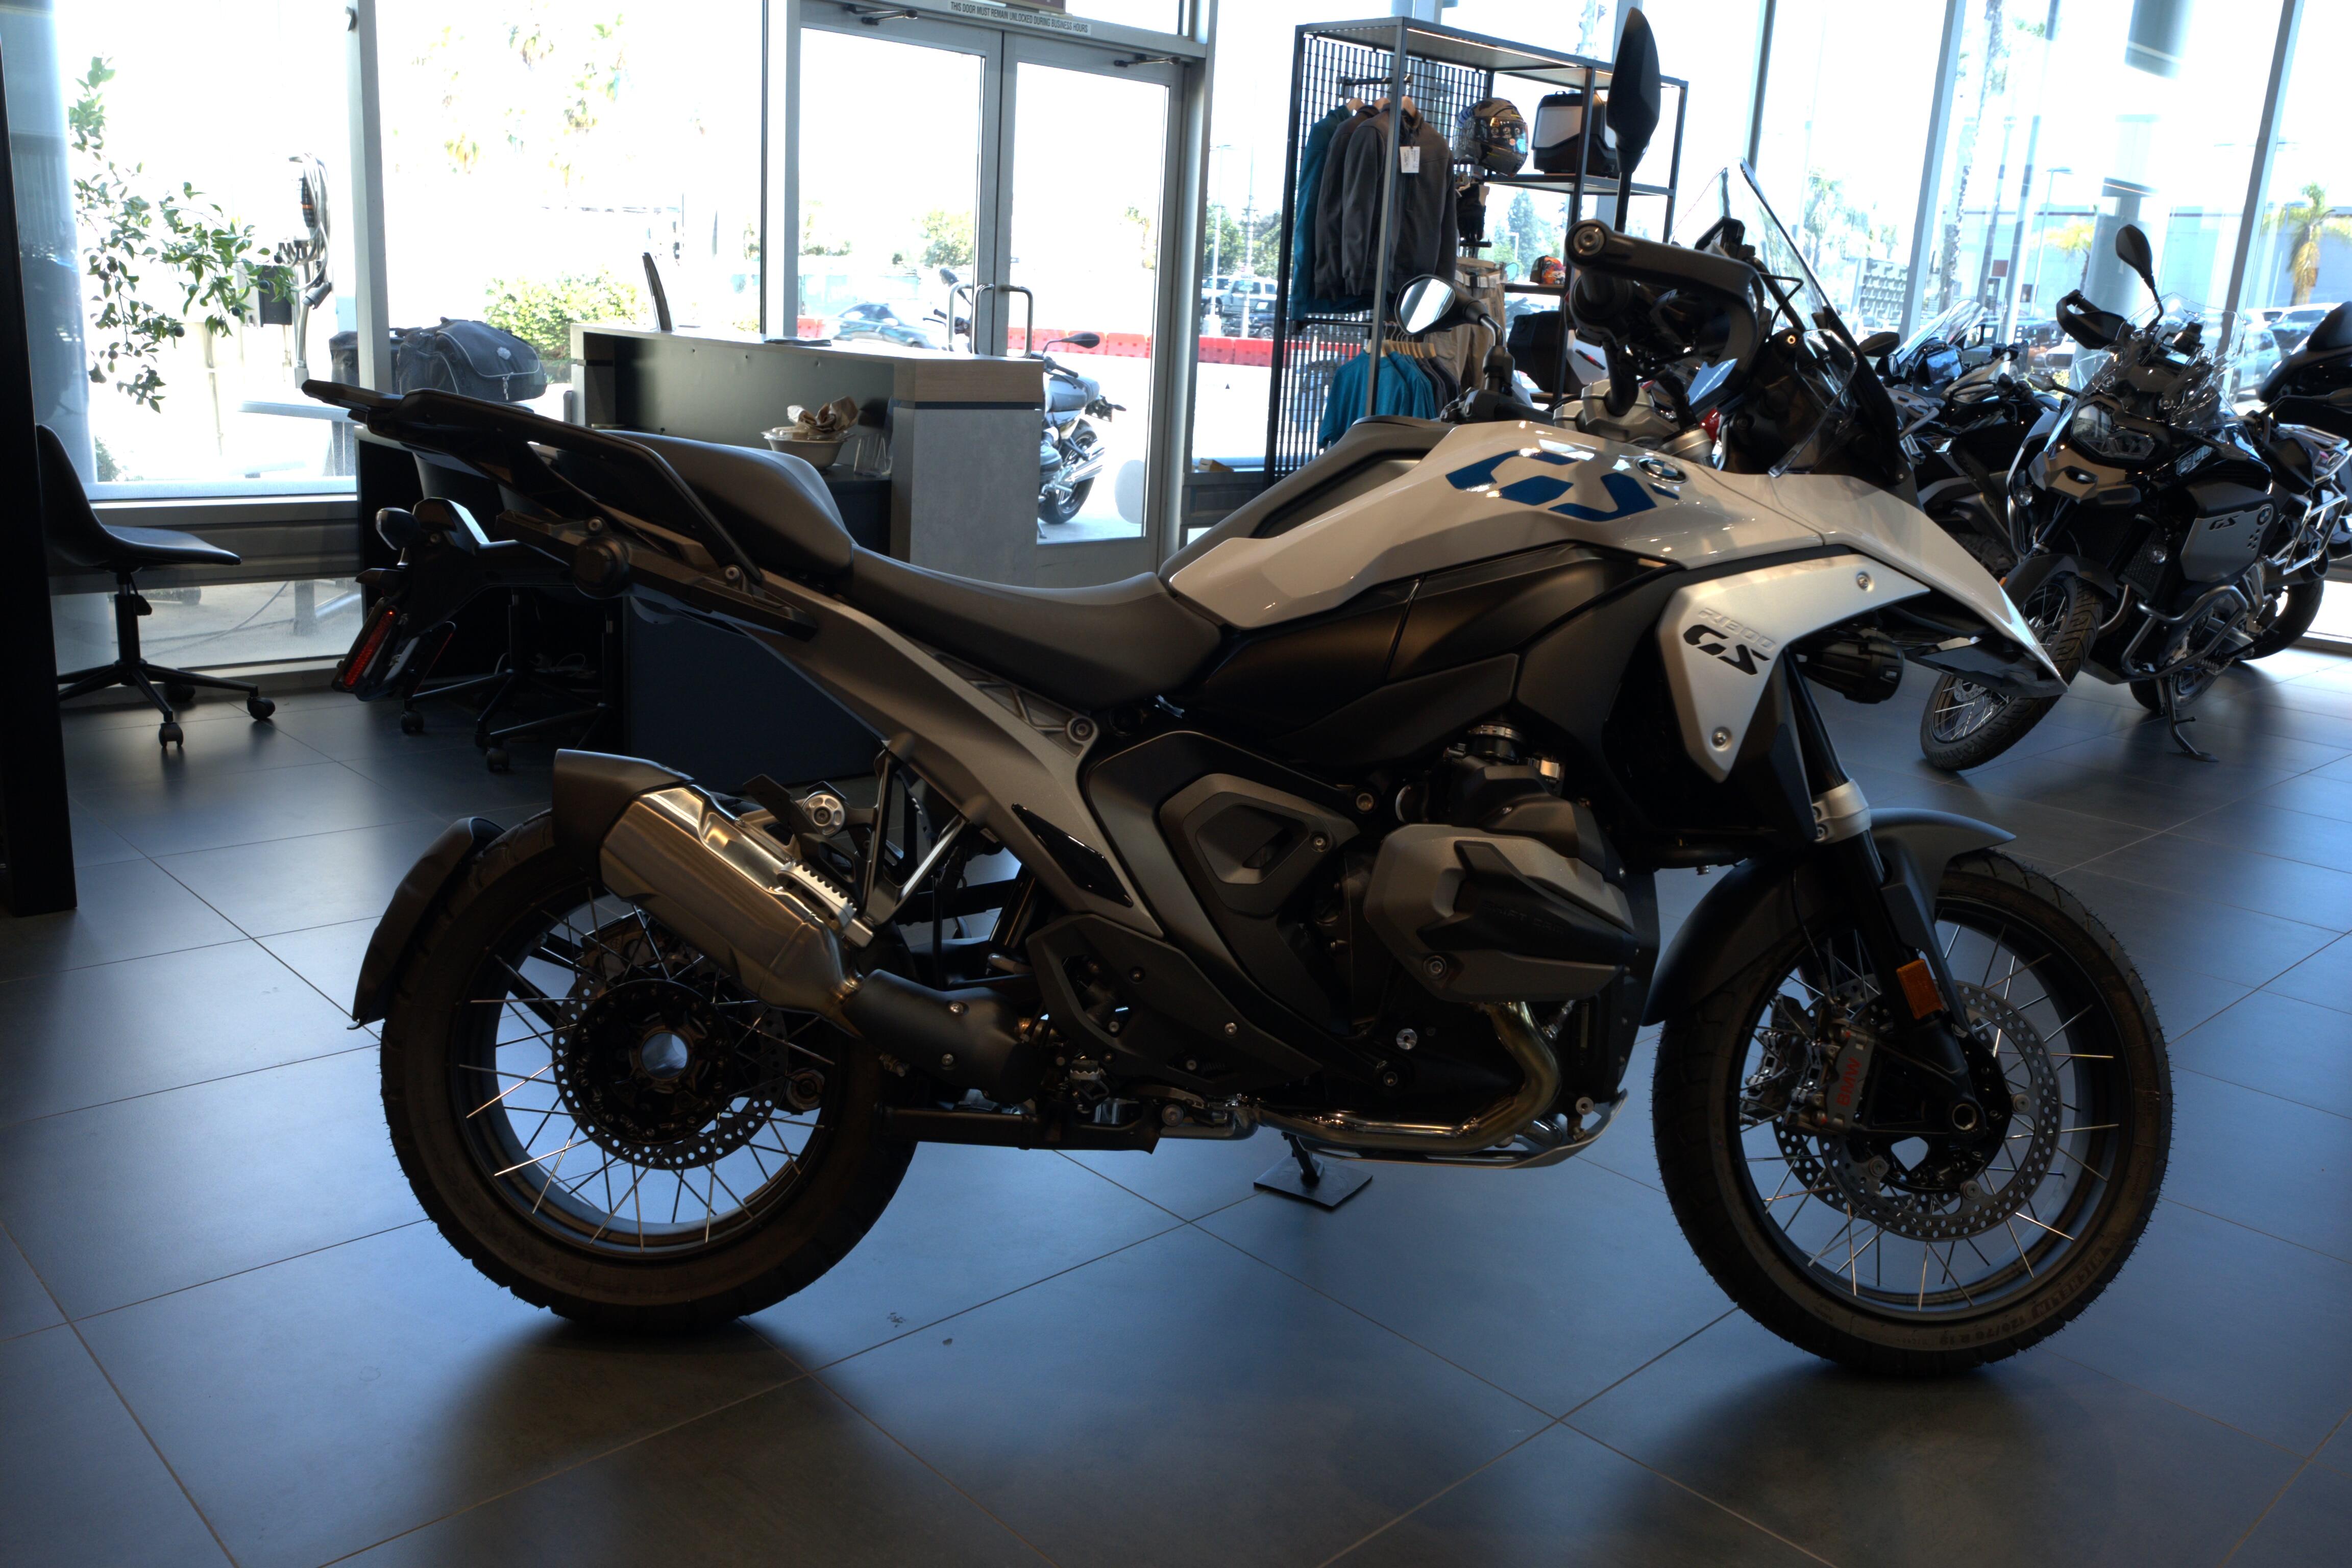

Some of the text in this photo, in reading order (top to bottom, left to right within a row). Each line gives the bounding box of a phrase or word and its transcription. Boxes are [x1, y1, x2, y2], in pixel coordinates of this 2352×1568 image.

[951, 2, 1088, 33] THIS DOOR MUST REMAIN UNLOCKED DURING BUSINESS HOURS
[1446, 450, 1679, 522] GS
[2209, 515, 2239, 530] GS
[1683, 624, 1770, 675] GS
[1836, 1056, 1861, 1107] BMW
[2033, 1248, 2109, 1315] MICHELIN
